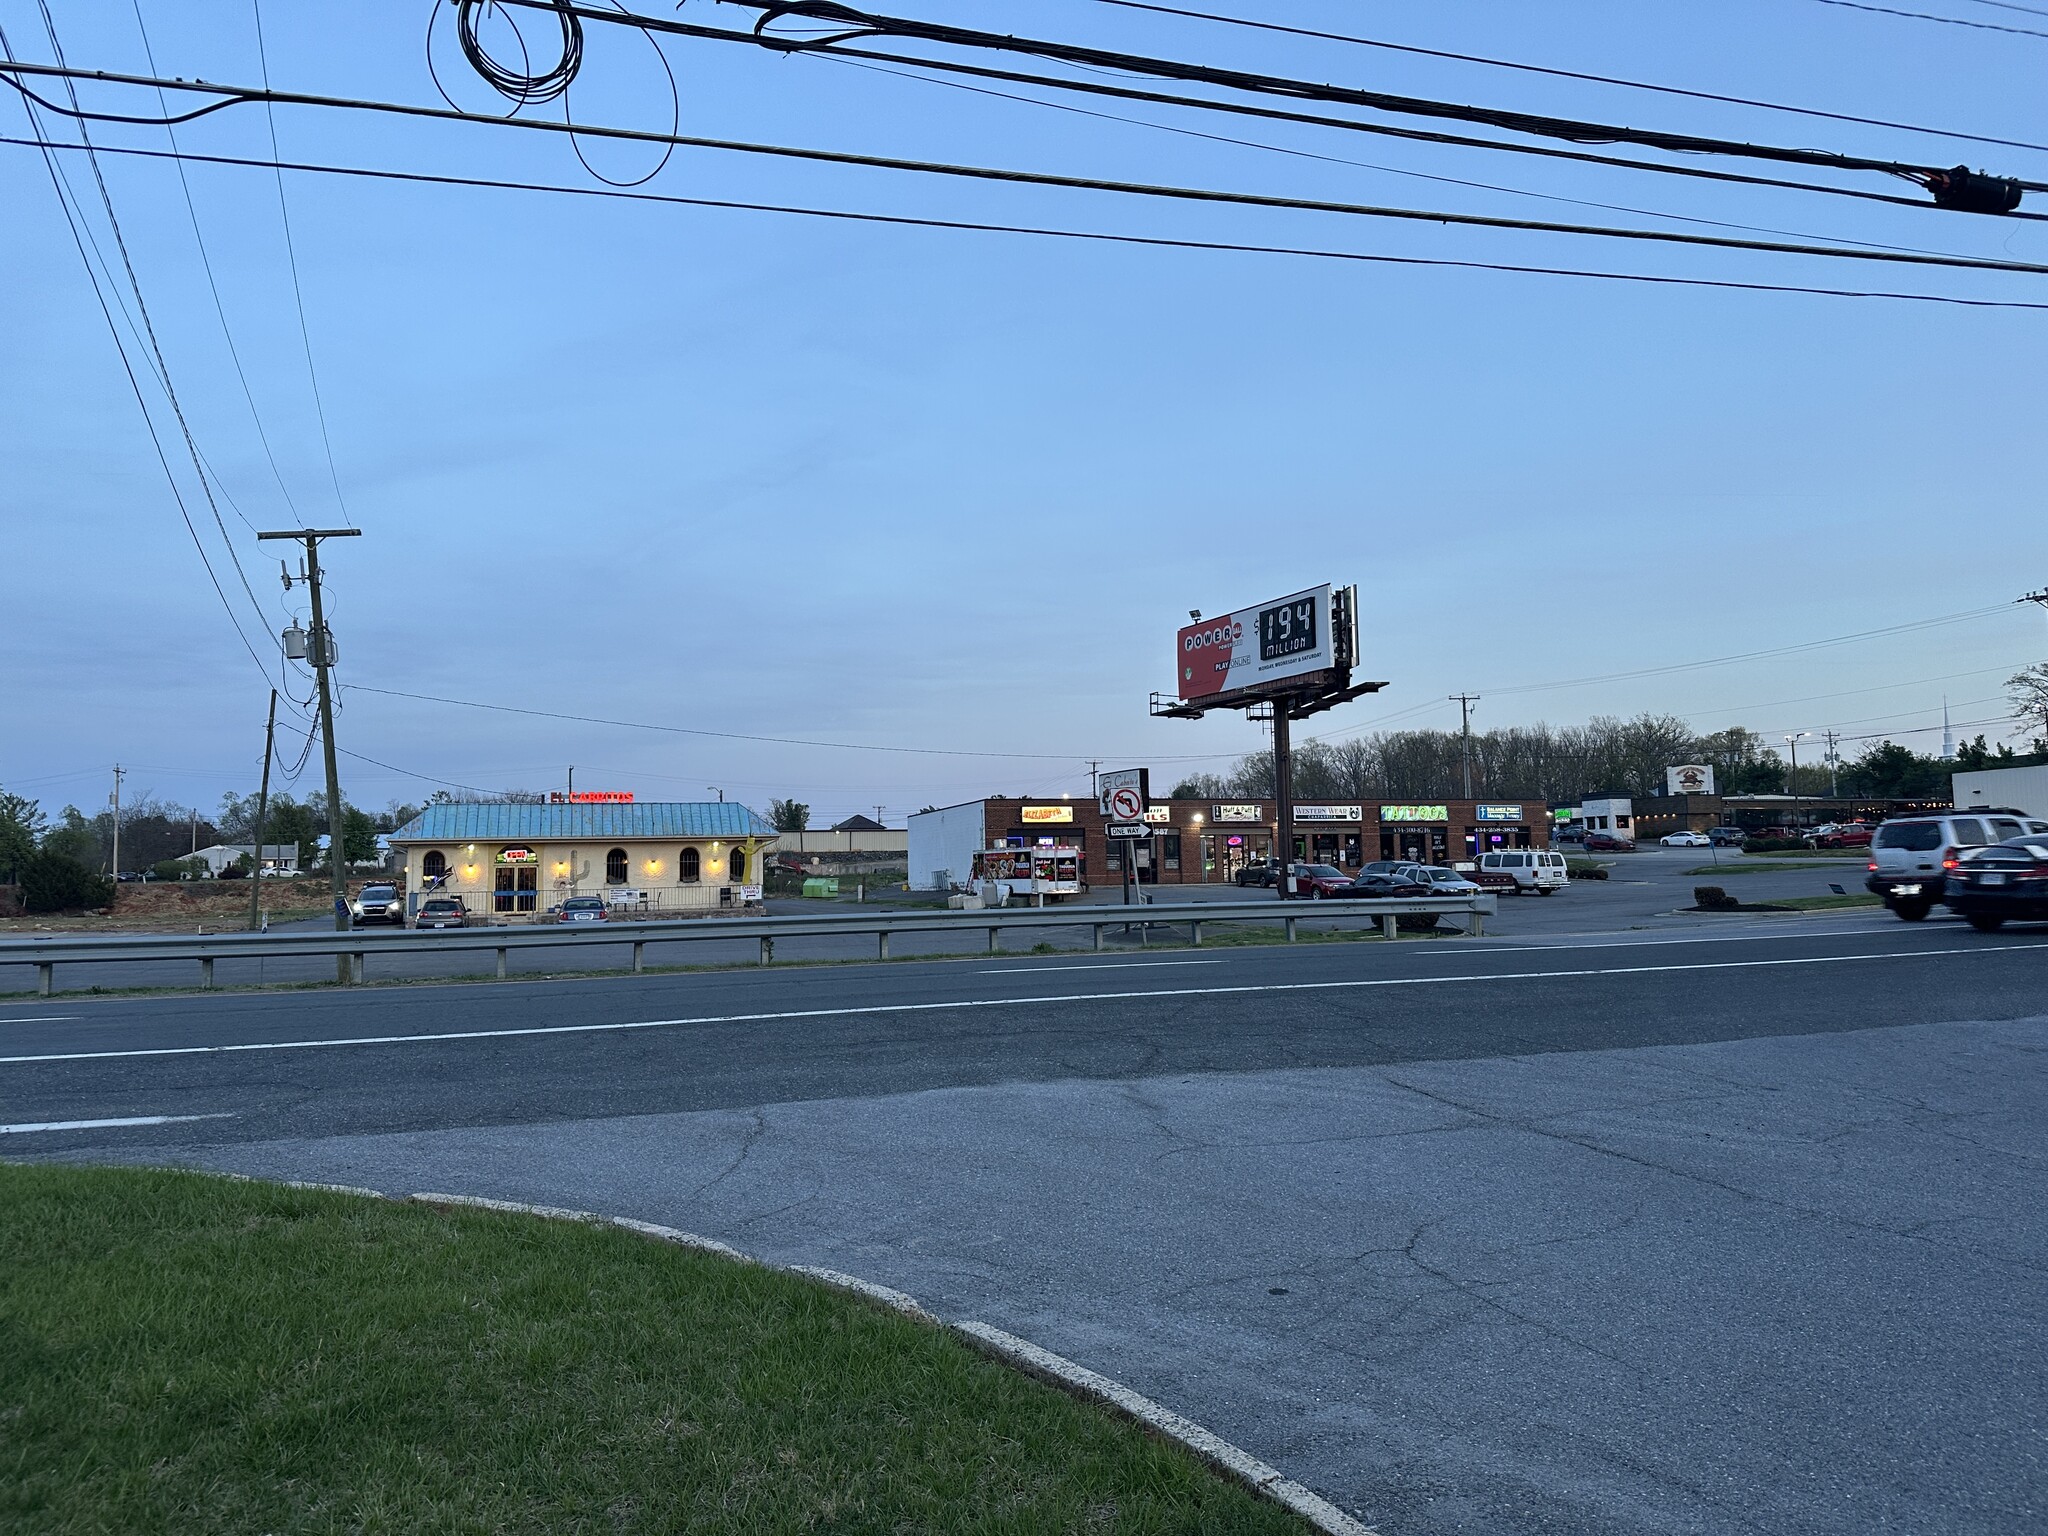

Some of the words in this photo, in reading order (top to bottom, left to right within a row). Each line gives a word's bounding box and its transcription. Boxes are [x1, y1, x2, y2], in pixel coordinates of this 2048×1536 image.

[1266, 636, 1306, 657] MILLION
[1301, 652, 1322, 662] SATURDAY
[1215, 661, 1230, 671] PLAY
[1230, 657, 1251, 668] ONLINE
[551, 792, 565, 803] EL
[569, 792, 634, 803] CABRITOS
[1145, 813, 1168, 821] ILS
[1381, 806, 1448, 821] TATTOOS
[506, 851, 526, 859] OPEN
